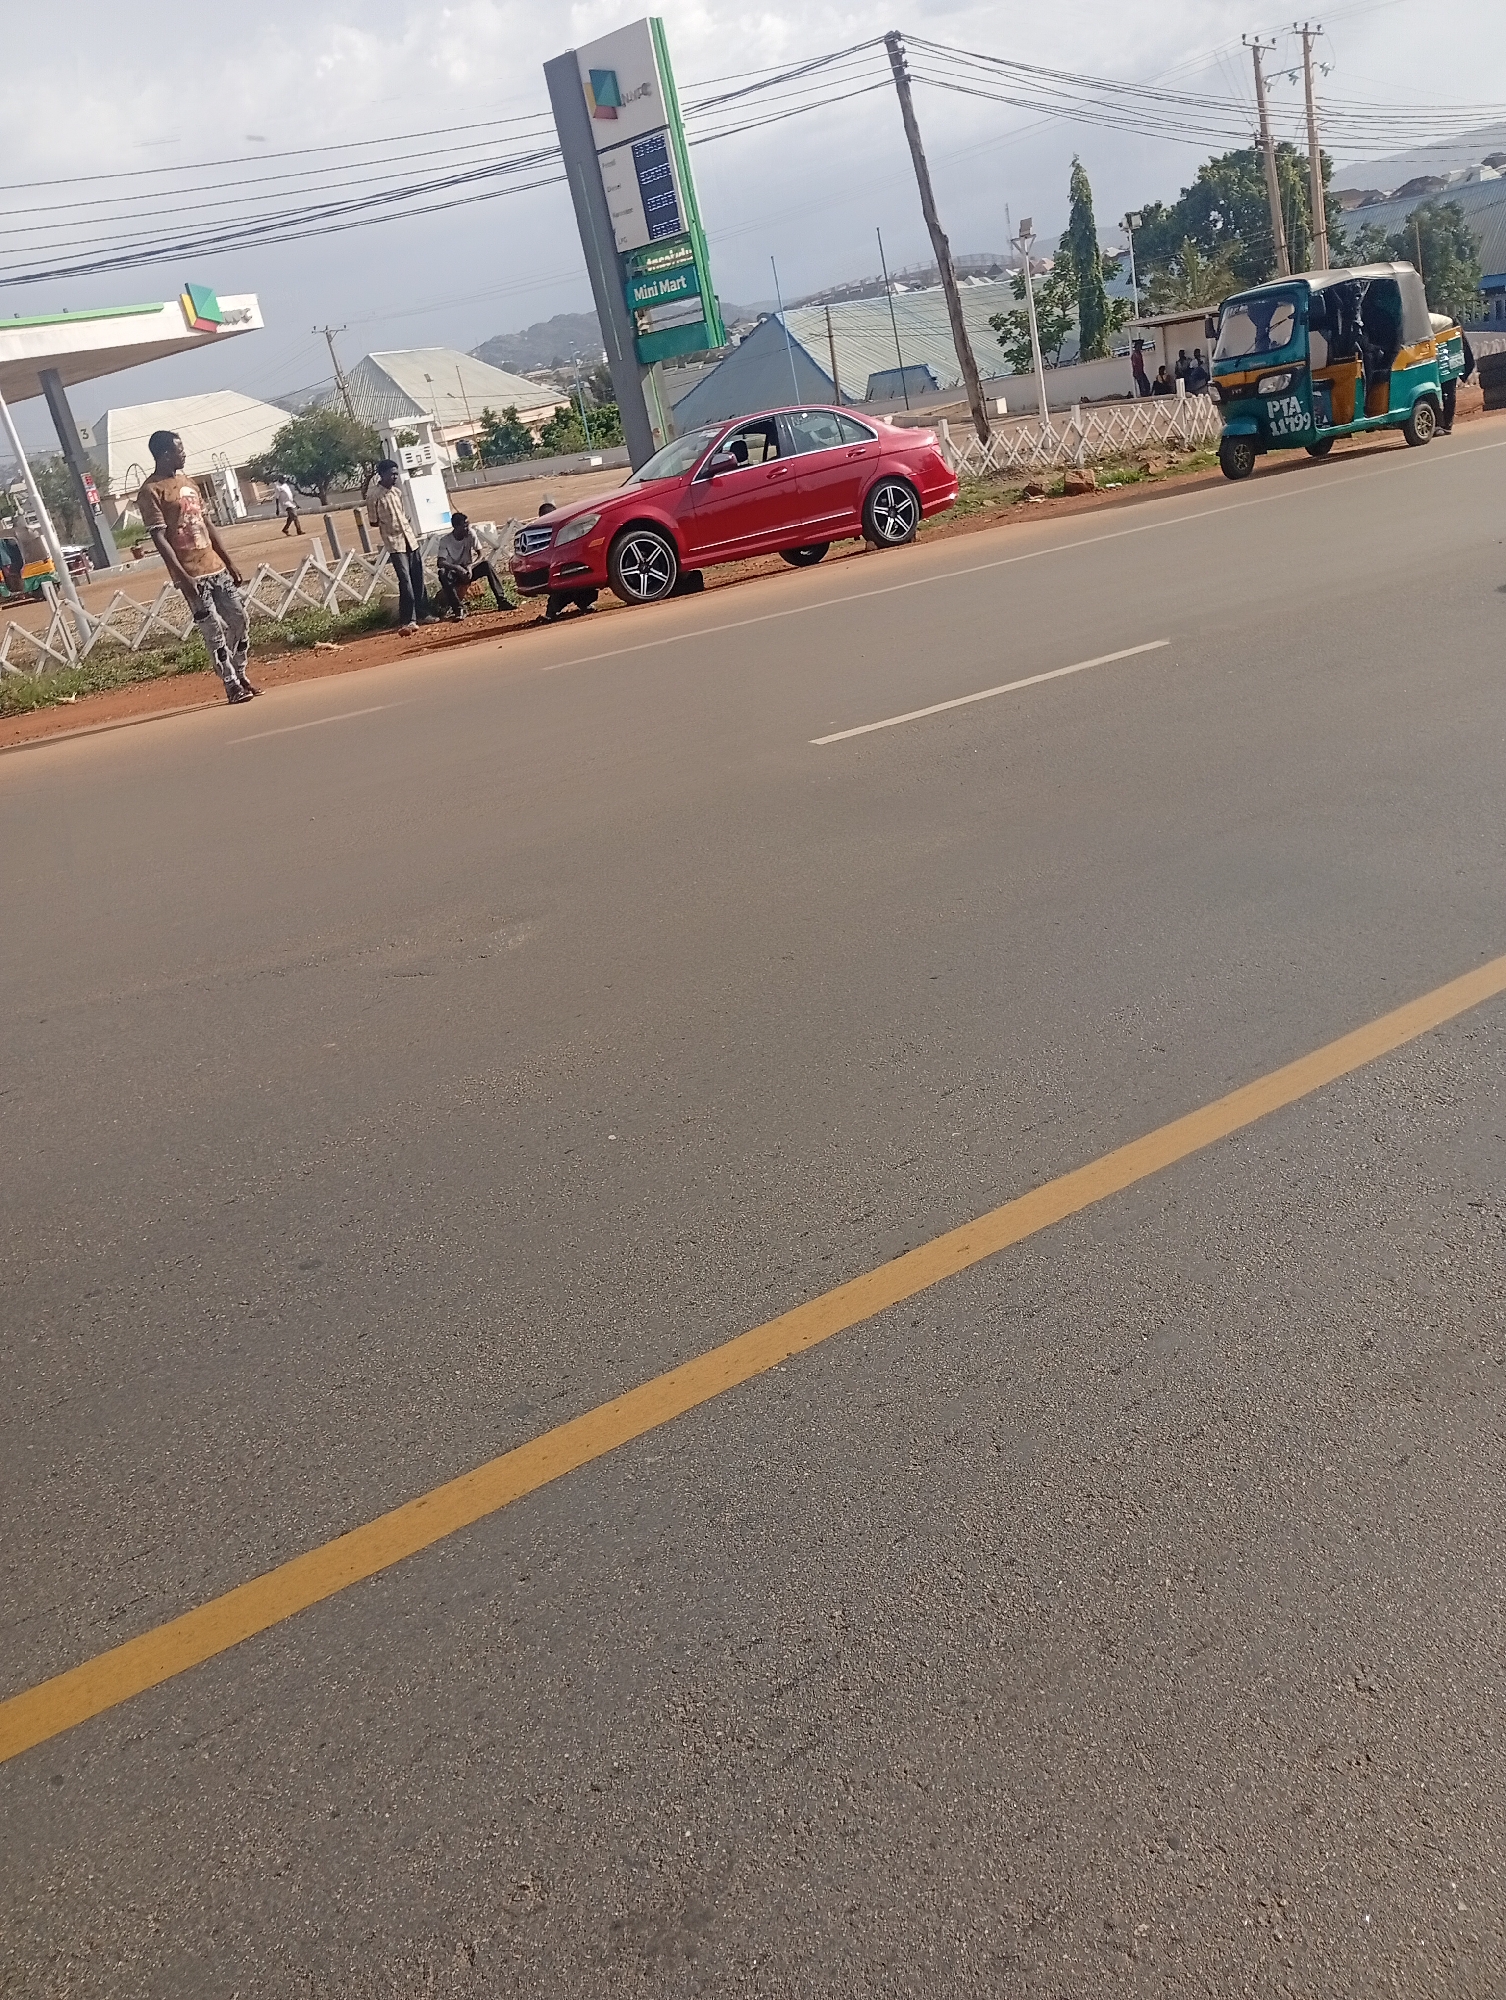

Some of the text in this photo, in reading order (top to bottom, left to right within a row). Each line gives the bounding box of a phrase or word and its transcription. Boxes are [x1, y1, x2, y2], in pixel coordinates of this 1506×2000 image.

[633, 275, 688, 301] Mini Mart
[1266, 396, 1302, 419] PTA
[80, 428, 90, 440] 3
